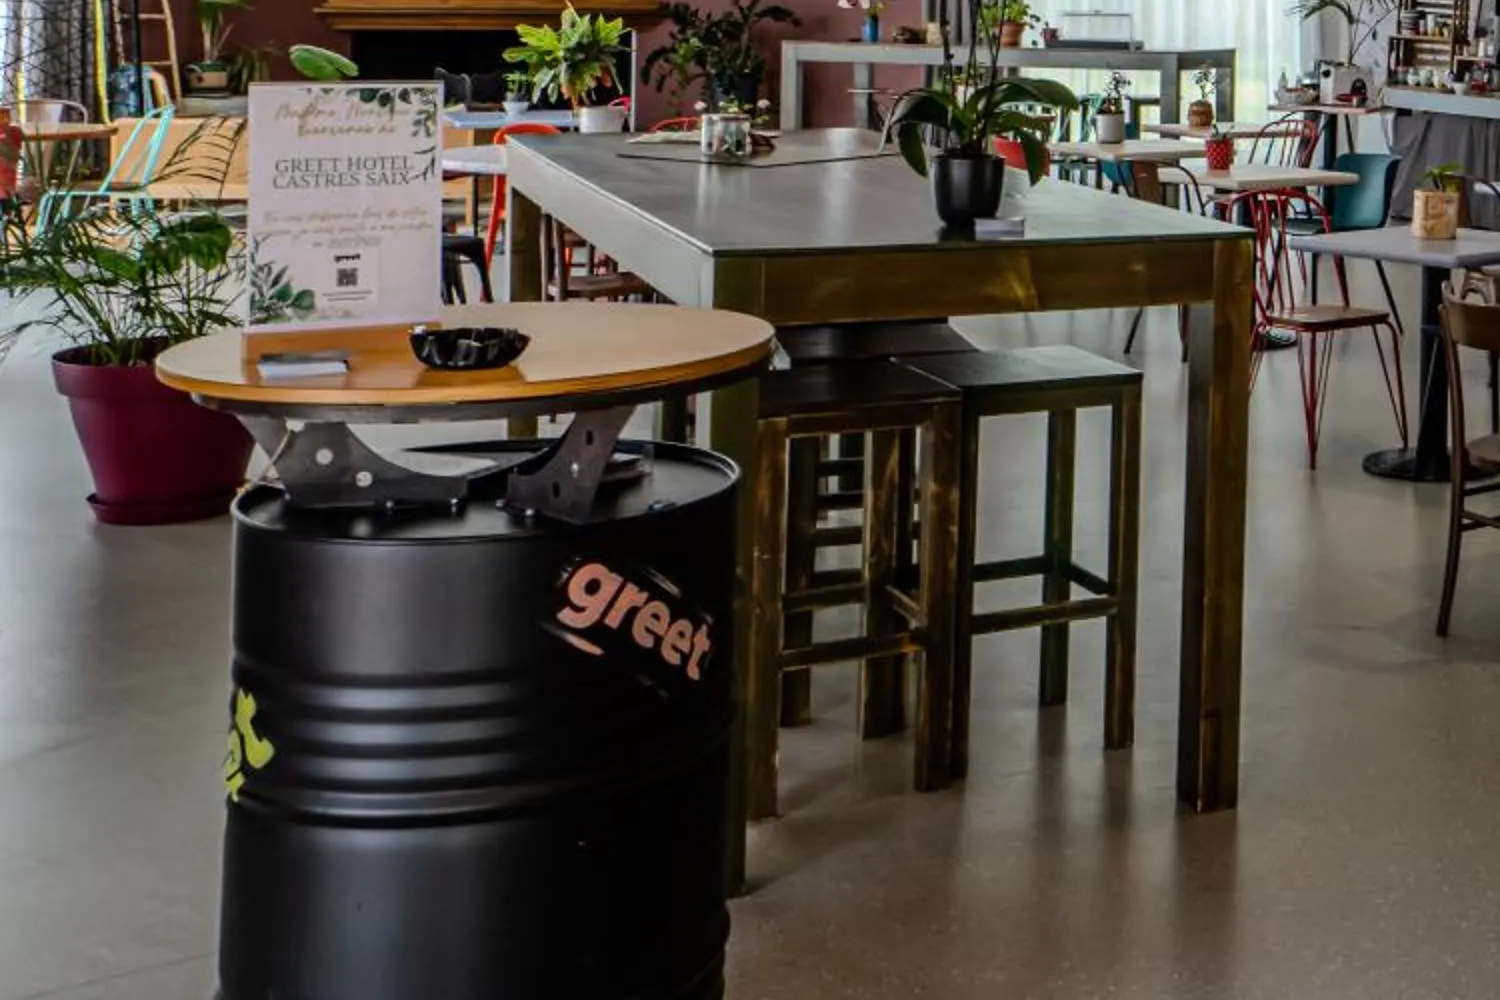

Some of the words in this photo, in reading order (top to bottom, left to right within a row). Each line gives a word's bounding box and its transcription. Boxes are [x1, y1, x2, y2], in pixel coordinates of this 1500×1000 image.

[275, 157, 340, 173] GREET
[347, 155, 415, 171] HOTEL
[272, 172, 361, 189] CASTRES
[365, 171, 411, 186] SAIX
[556, 563, 711, 681] greet
